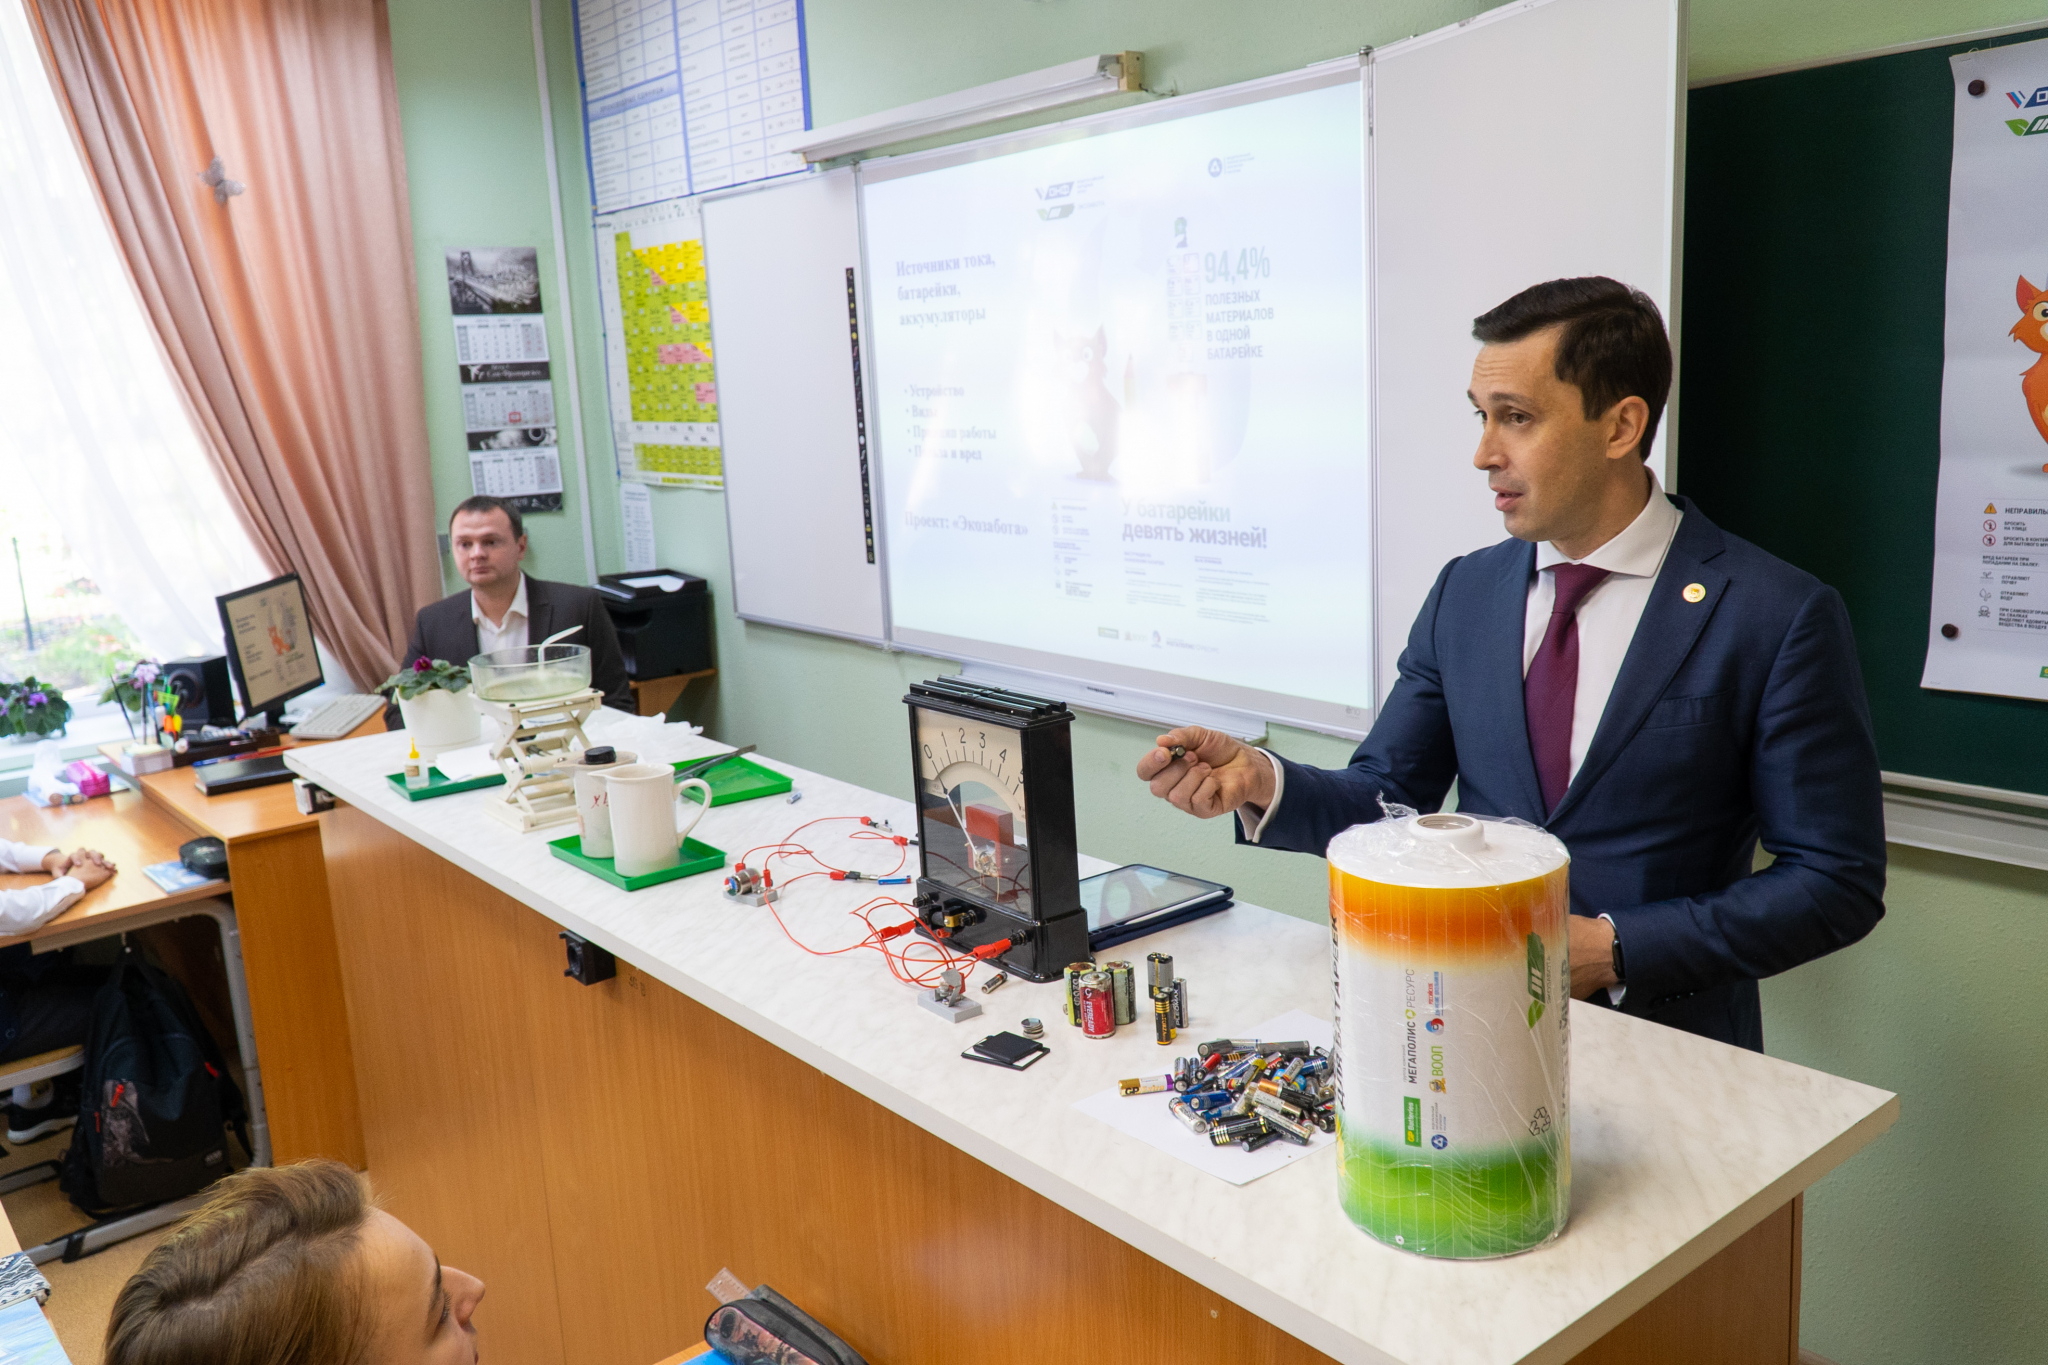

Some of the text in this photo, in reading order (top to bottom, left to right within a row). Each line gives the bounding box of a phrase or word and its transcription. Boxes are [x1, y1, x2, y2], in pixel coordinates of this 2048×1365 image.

[896, 253, 996, 277] Источники тока,
[1204, 246, 1270, 286] 94,4%
[898, 282, 961, 303] батарейки,
[1206, 290, 1260, 306] ПОЛЕЗНЫХ
[899, 308, 986, 328] аккумуляторы
[1206, 307, 1274, 324] МАТЕРИАЛОВ
[1207, 325, 1250, 344] В ОДНОЙ
[1207, 344, 1264, 360] БАТАРЕЙКЕ
[960, 426, 997, 442] работы
[960, 449, 982, 463] вред
[1137, 499, 1230, 524] батарейки
[905, 511, 1028, 536] Проект: «Экозабота»
[1122, 523, 1268, 549] девять жизней!
[924, 727, 1025, 784] 0 1 2 3 4 5
[1086, 1001, 1095, 1033] EVEREADY
[1331, 914, 1346, 1111] ДЛЯ БАТАРЕЕК
[1405, 969, 1417, 1084] МЕГАПОЛИС РЕСУРС
[1431, 1046, 1444, 1076] ВООП
[1125, 1085, 1164, 1095] GP Extra
[1408, 1131, 1415, 1143] GP
